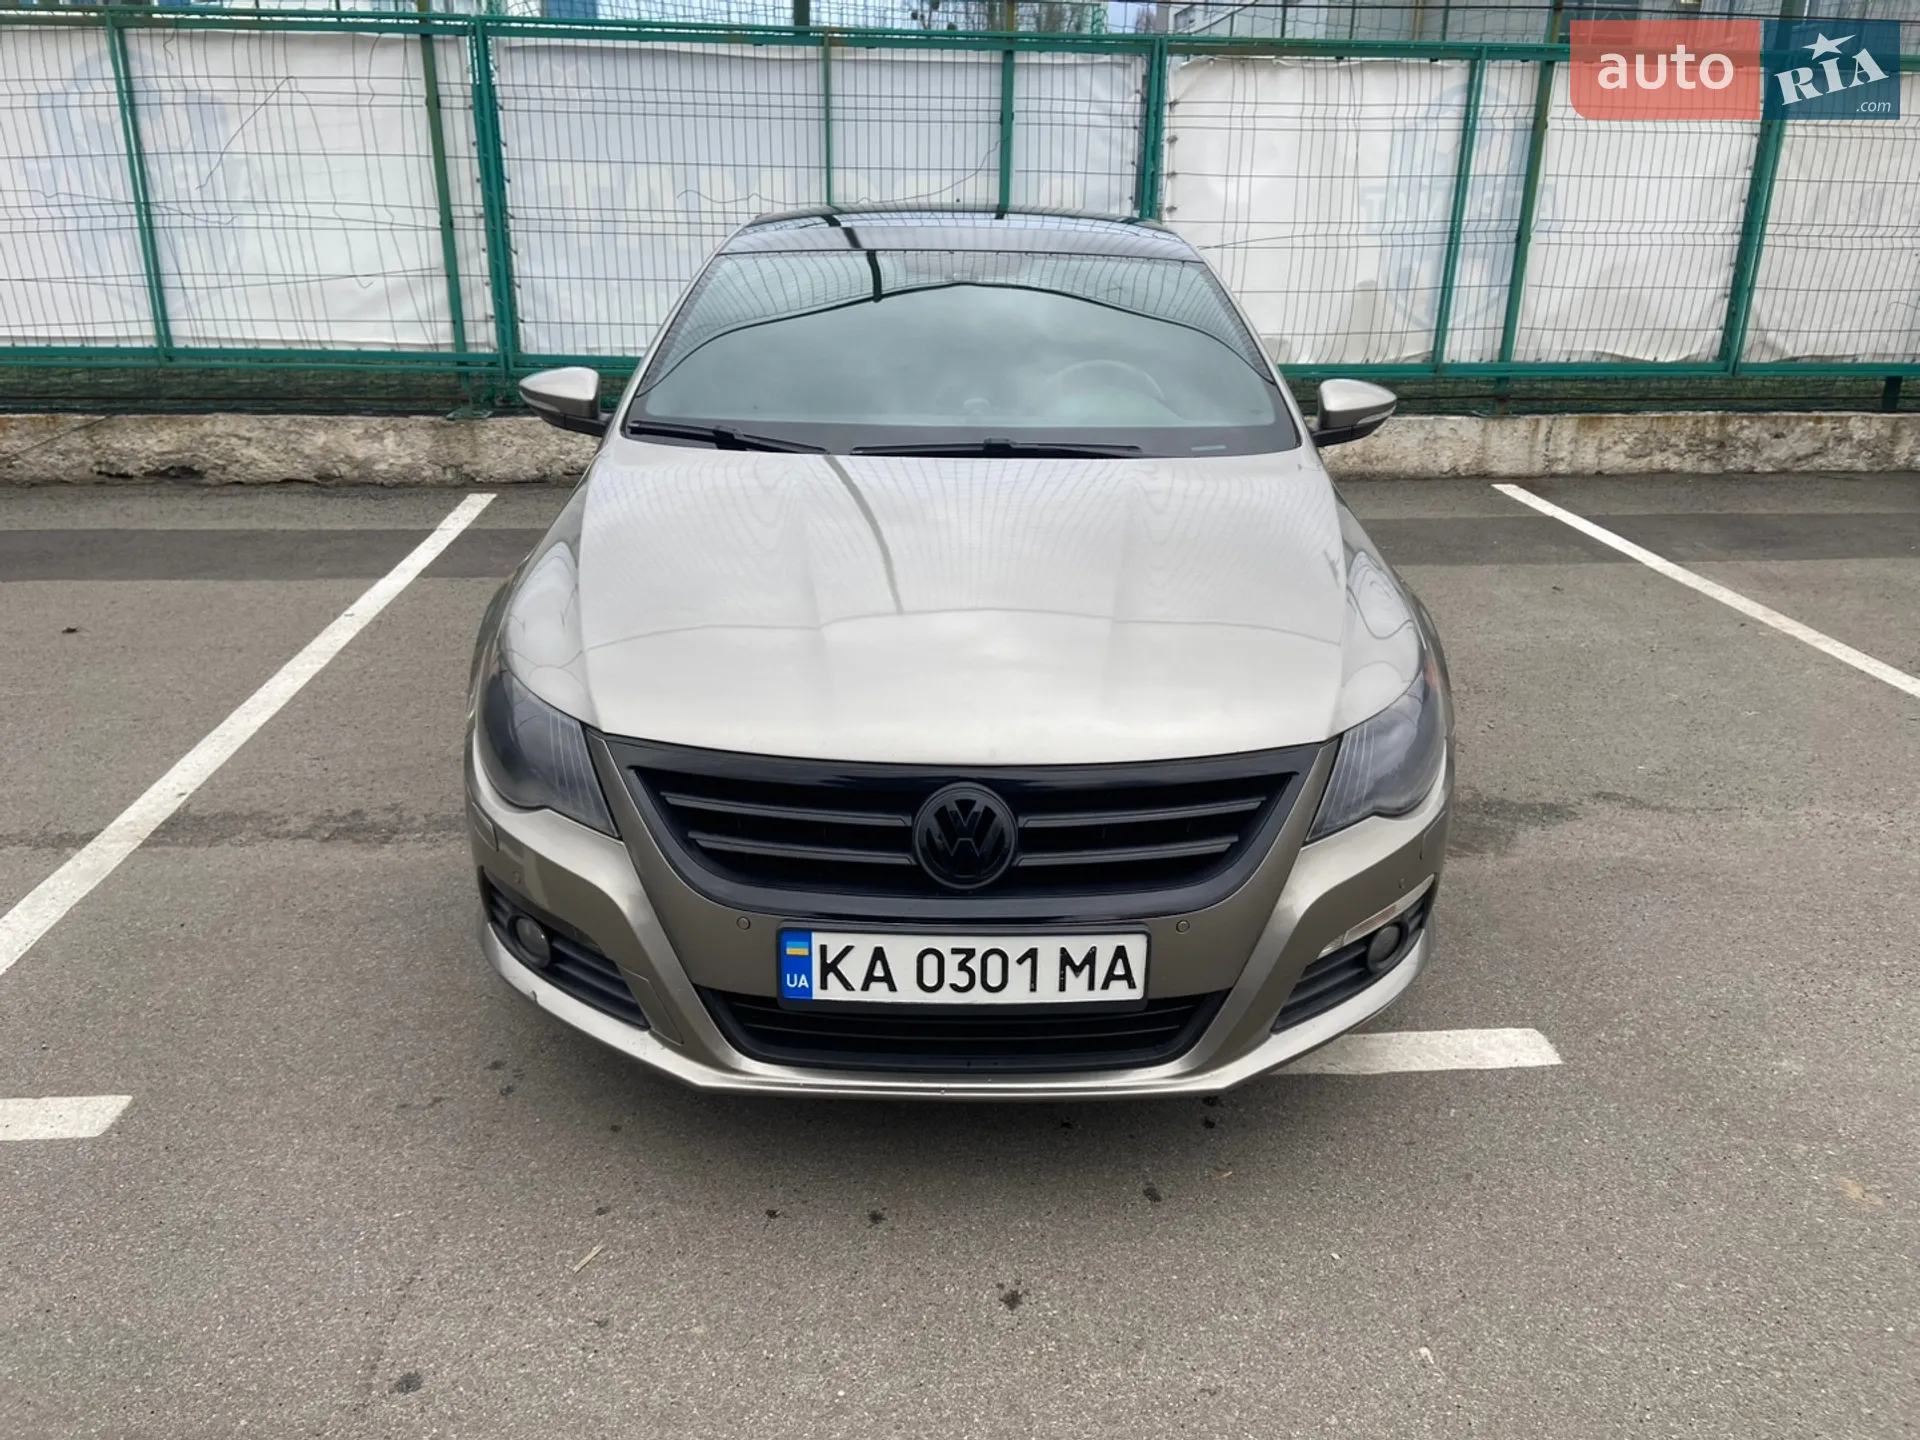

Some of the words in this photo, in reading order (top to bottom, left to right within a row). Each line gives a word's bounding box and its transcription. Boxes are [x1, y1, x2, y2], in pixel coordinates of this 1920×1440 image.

[786, 973, 809, 989] UA
[819, 944, 898, 992] KA
[916, 946, 1038, 994] 0301
[1058, 944, 1137, 992] MA
